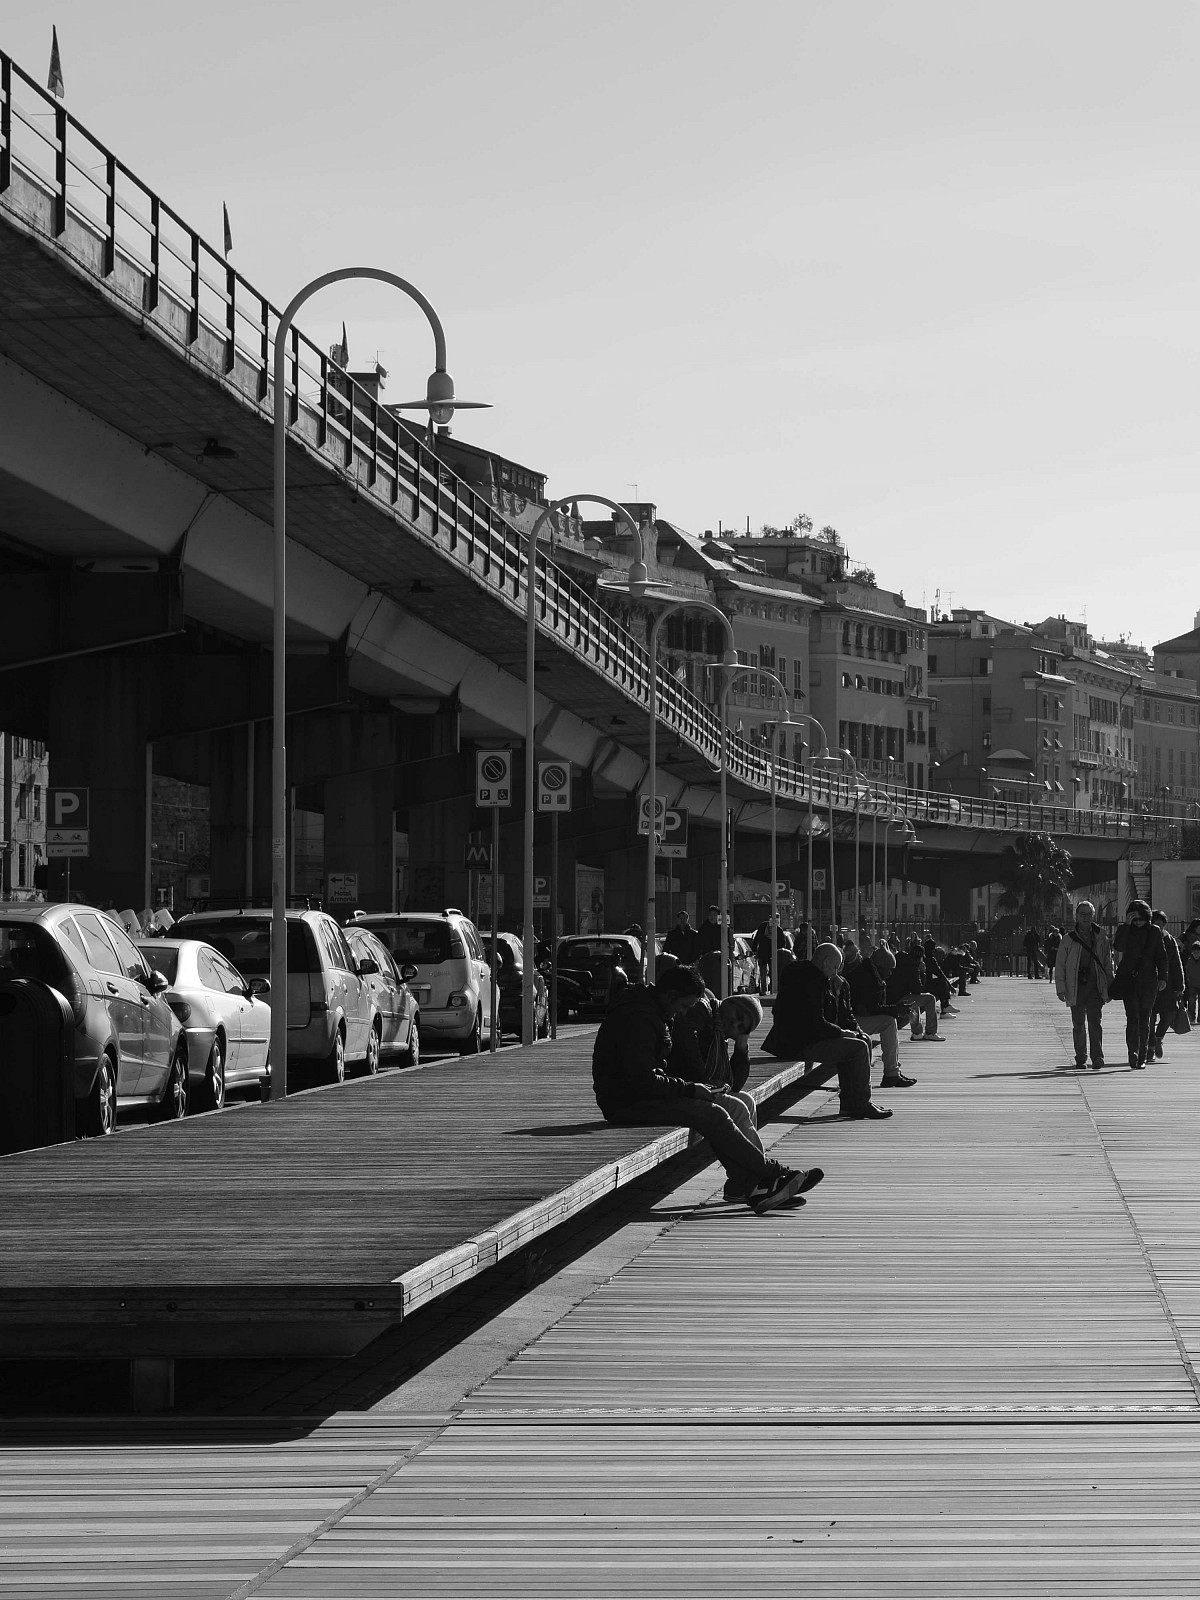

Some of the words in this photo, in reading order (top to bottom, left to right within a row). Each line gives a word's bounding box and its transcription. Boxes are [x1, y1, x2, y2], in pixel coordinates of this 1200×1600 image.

[481, 790, 489, 799] P
[543, 795, 550, 803] P
[54, 792, 80, 825] P
[466, 846, 489, 861] M
[535, 877, 547, 893] P
[776, 882, 786, 897] P
